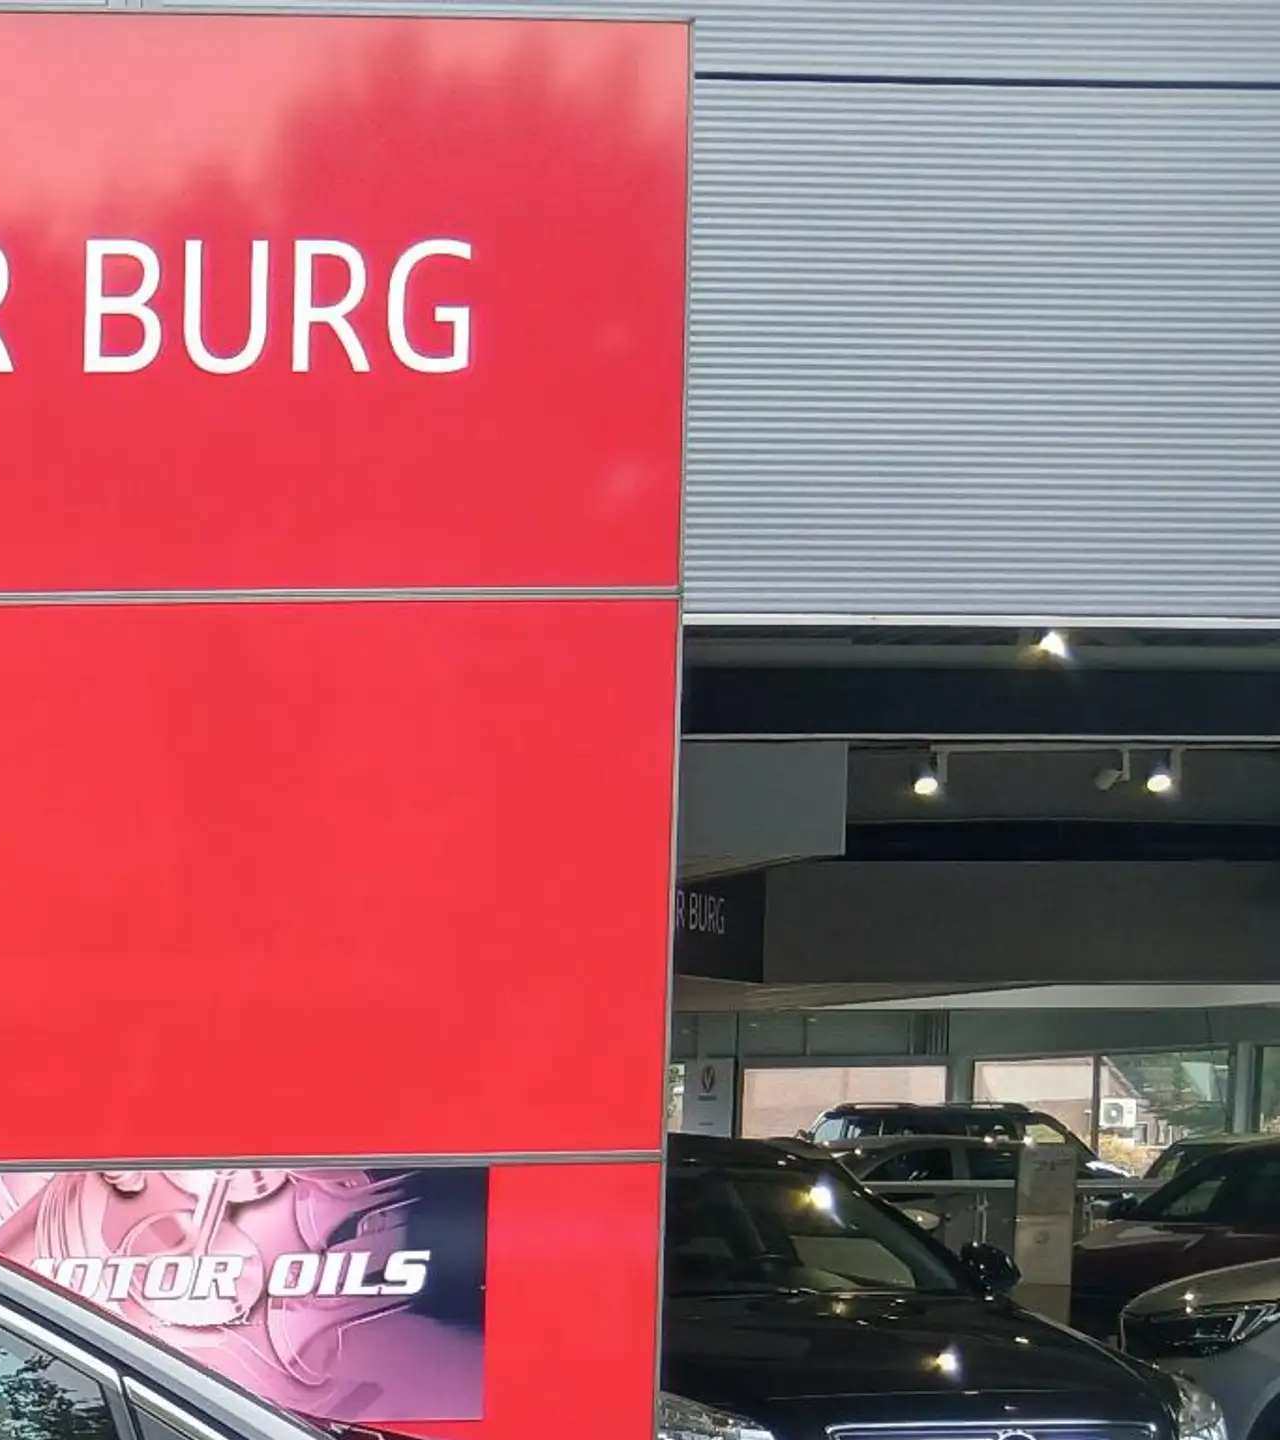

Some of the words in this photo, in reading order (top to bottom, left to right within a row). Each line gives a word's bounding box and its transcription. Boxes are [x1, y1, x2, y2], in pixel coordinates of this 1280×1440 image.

[81, 238, 472, 375] BURG
[689, 892, 726, 935] BURG
[267, 1249, 432, 1298] OILS
